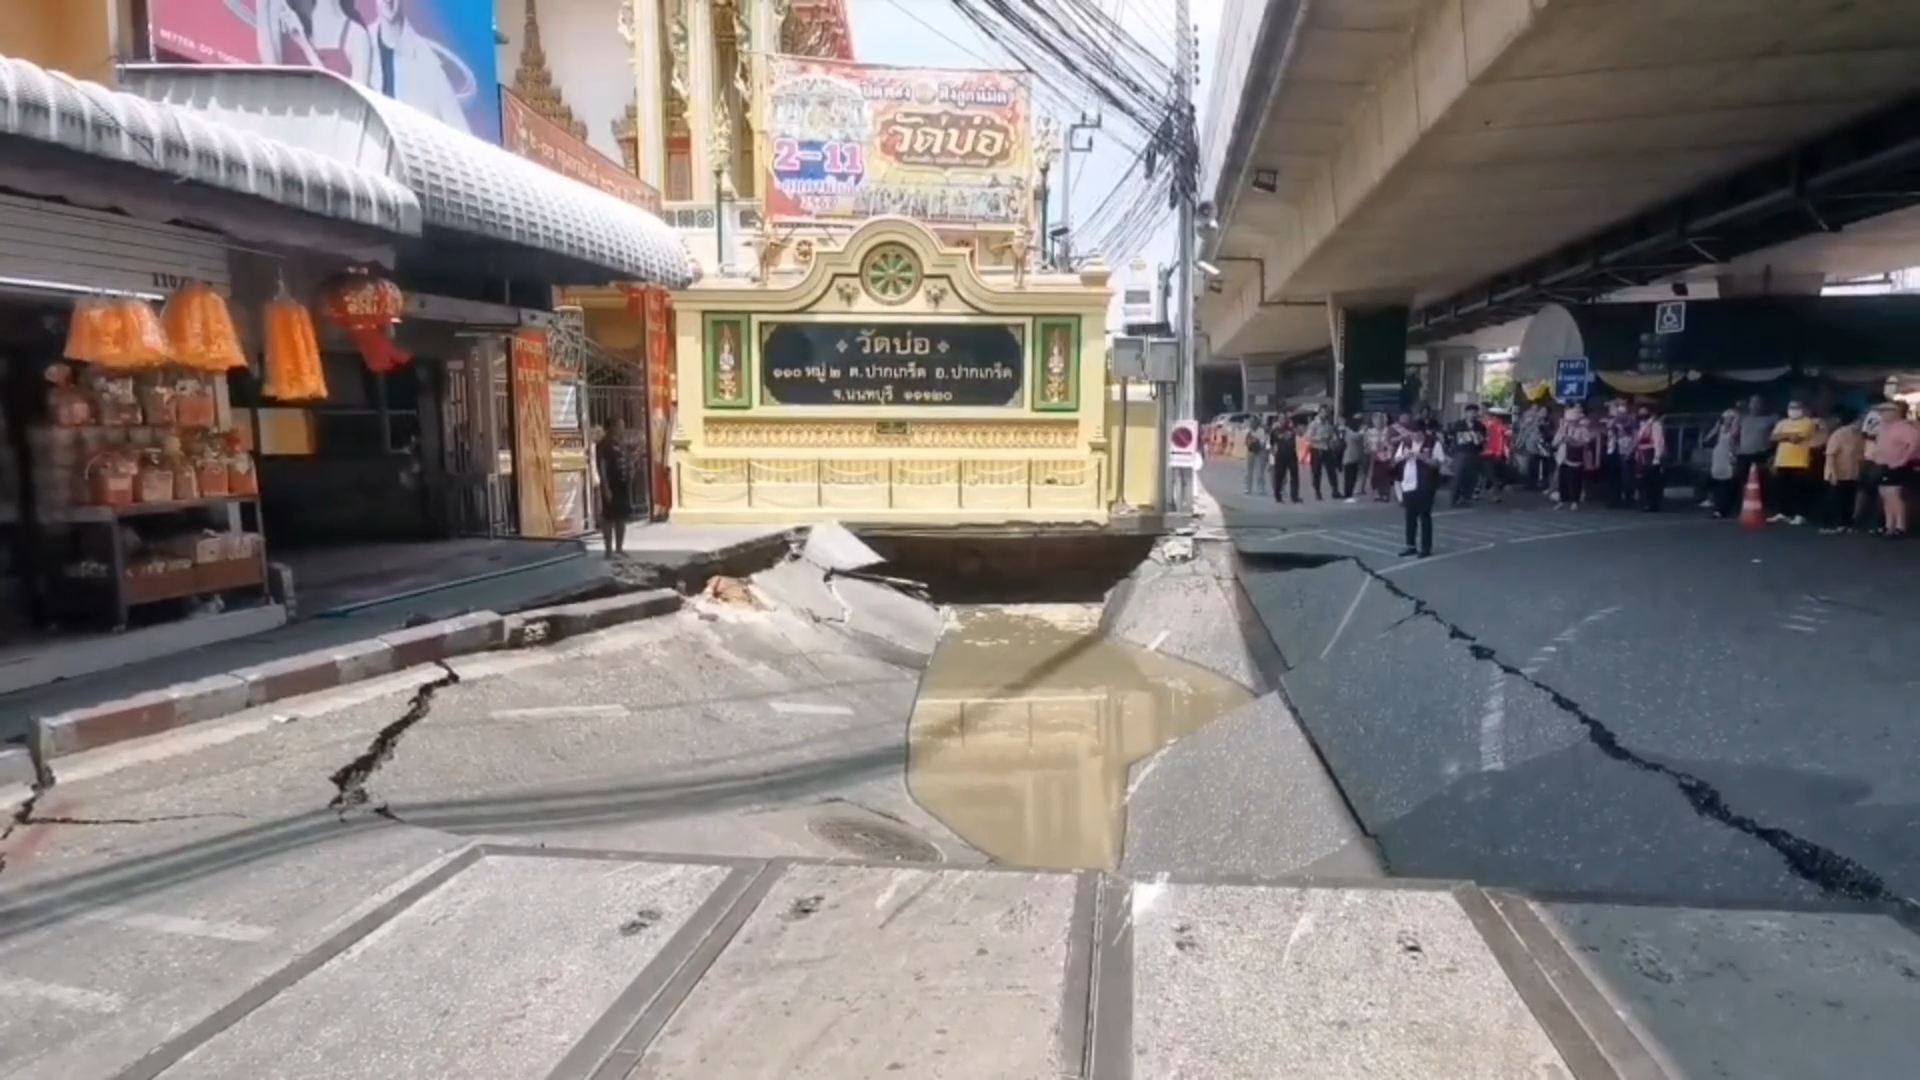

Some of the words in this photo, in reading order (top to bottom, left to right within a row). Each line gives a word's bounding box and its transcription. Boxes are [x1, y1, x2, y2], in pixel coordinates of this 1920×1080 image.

[888, 110, 1006, 158] วัดบ่อ
[855, 328, 931, 355] วัดบ่อ
[772, 367, 802, 379] ๑๑๐
[805, 361, 827, 384] หมู่
[829, 367, 841, 379] ๒
